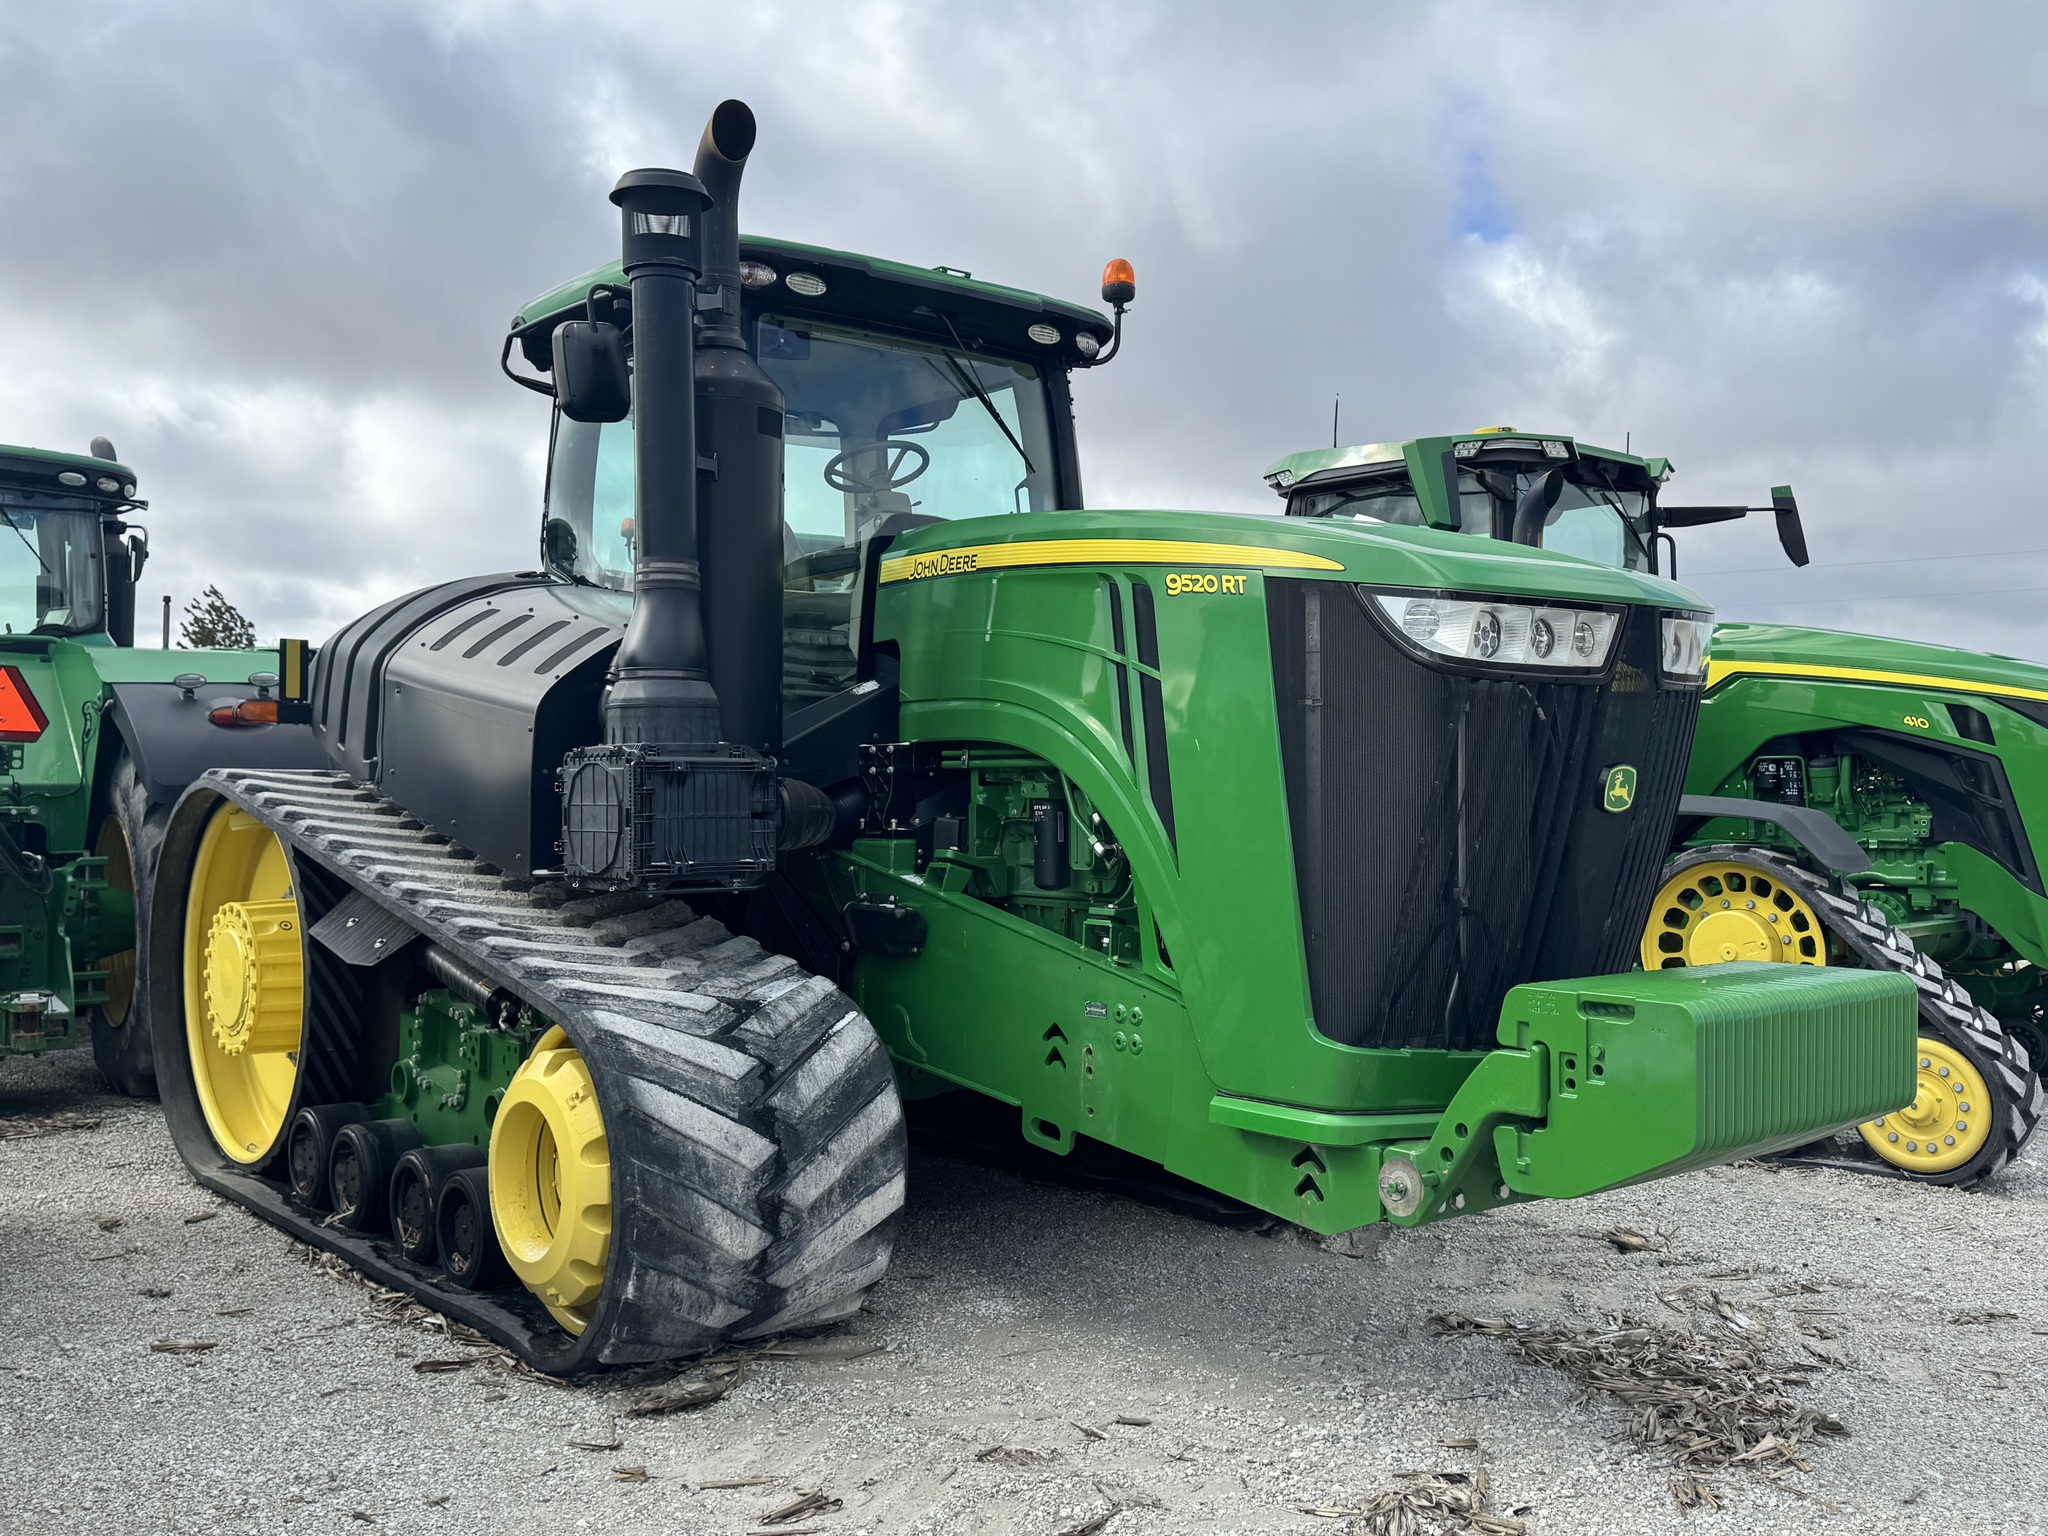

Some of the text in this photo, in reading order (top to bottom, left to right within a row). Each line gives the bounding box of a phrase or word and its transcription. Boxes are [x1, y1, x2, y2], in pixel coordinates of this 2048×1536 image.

[909, 554, 978, 579] JOHN DEERE
[1165, 573, 1248, 595] 9520 RT
[1903, 715, 1930, 729] 410
